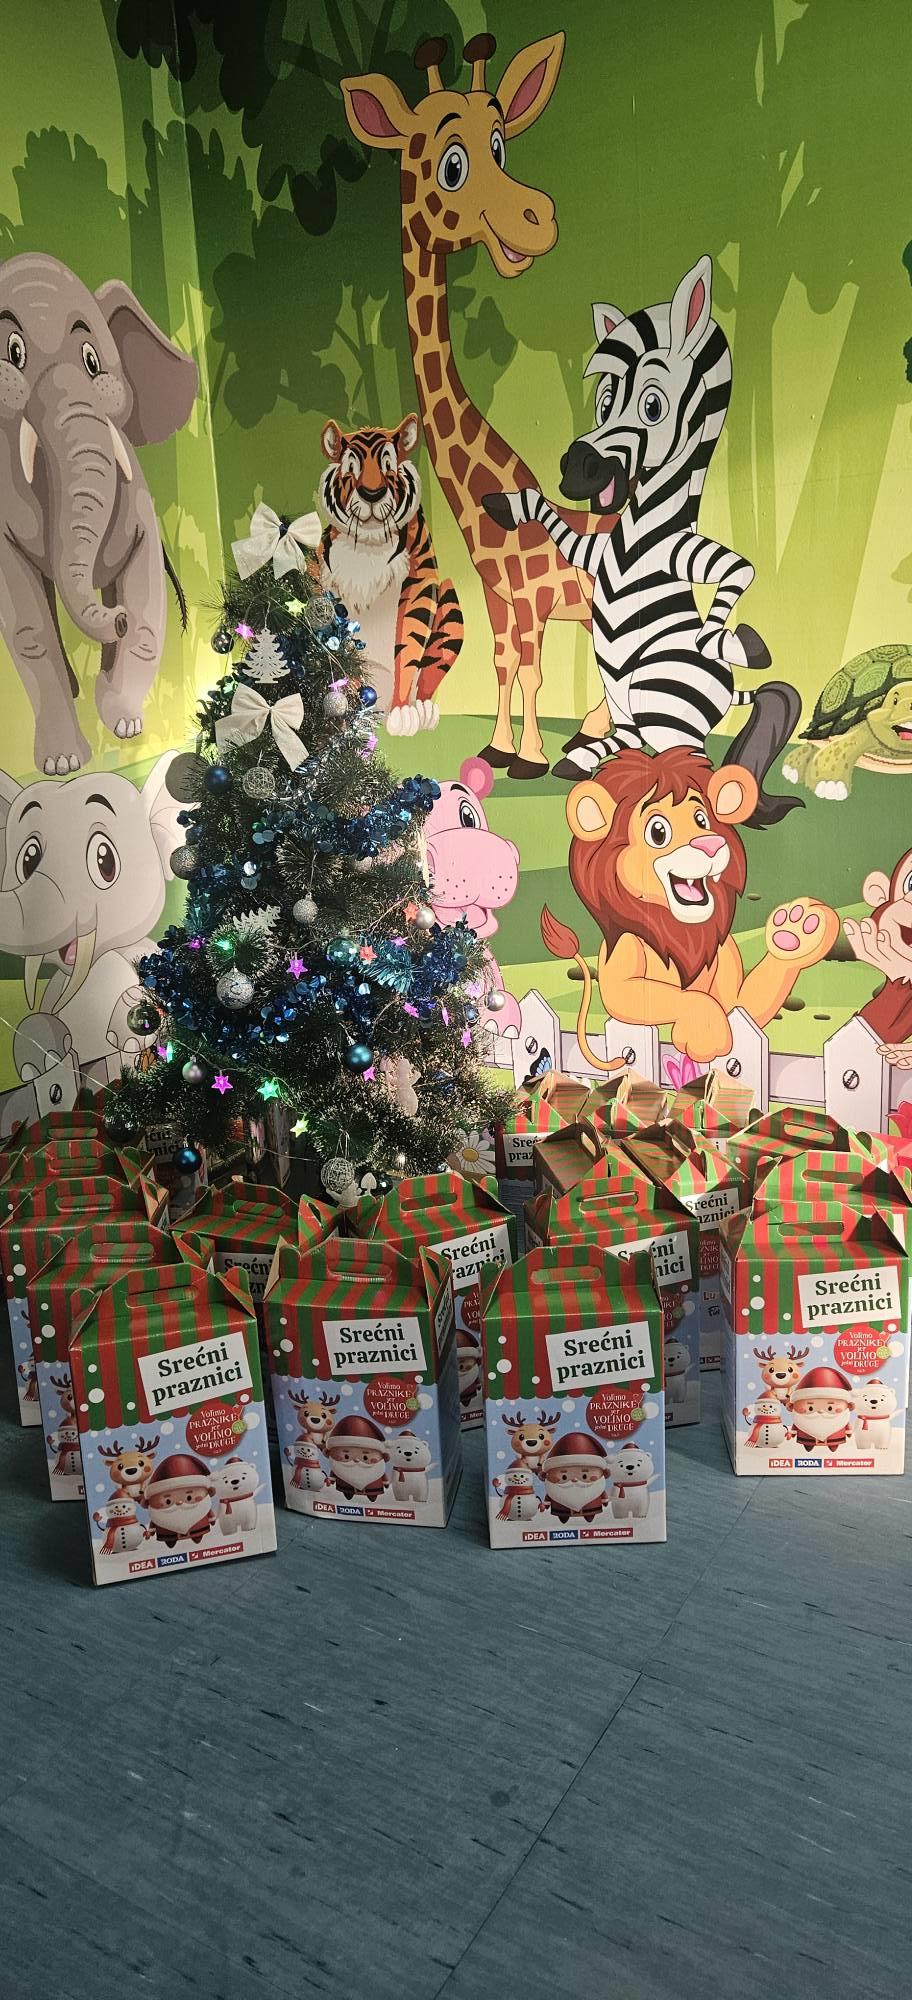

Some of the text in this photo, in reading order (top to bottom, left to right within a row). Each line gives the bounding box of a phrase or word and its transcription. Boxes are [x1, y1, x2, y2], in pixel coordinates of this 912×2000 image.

[512, 1136, 538, 1147] Sreć
[508, 1152, 533, 1162] praz
[685, 1193, 728, 1210] Srećni
[697, 1206, 735, 1223] aznici
[441, 1233, 496, 1260] Srećni
[656, 1256, 685, 1277] nici
[815, 1272, 882, 1296] Srećni
[807, 1292, 893, 1321] praznici
[340, 1322, 405, 1344] Srećni
[564, 1329, 633, 1357] Srećni
[157, 1342, 229, 1378] Srećni
[333, 1343, 418, 1369] praznici
[840, 1351, 877, 1360] VOLIMO
[556, 1350, 646, 1384] praznici
[152, 1361, 243, 1406] praznici
[371, 1402, 406, 1411] VOLIMO
[594, 1414, 631, 1424] VOLIMO
[194, 1428, 232, 1443] VOLIMO
[377, 1510, 412, 1518] Mercator
[593, 1529, 631, 1537] Mercator
[202, 1545, 241, 1558] Mercator
